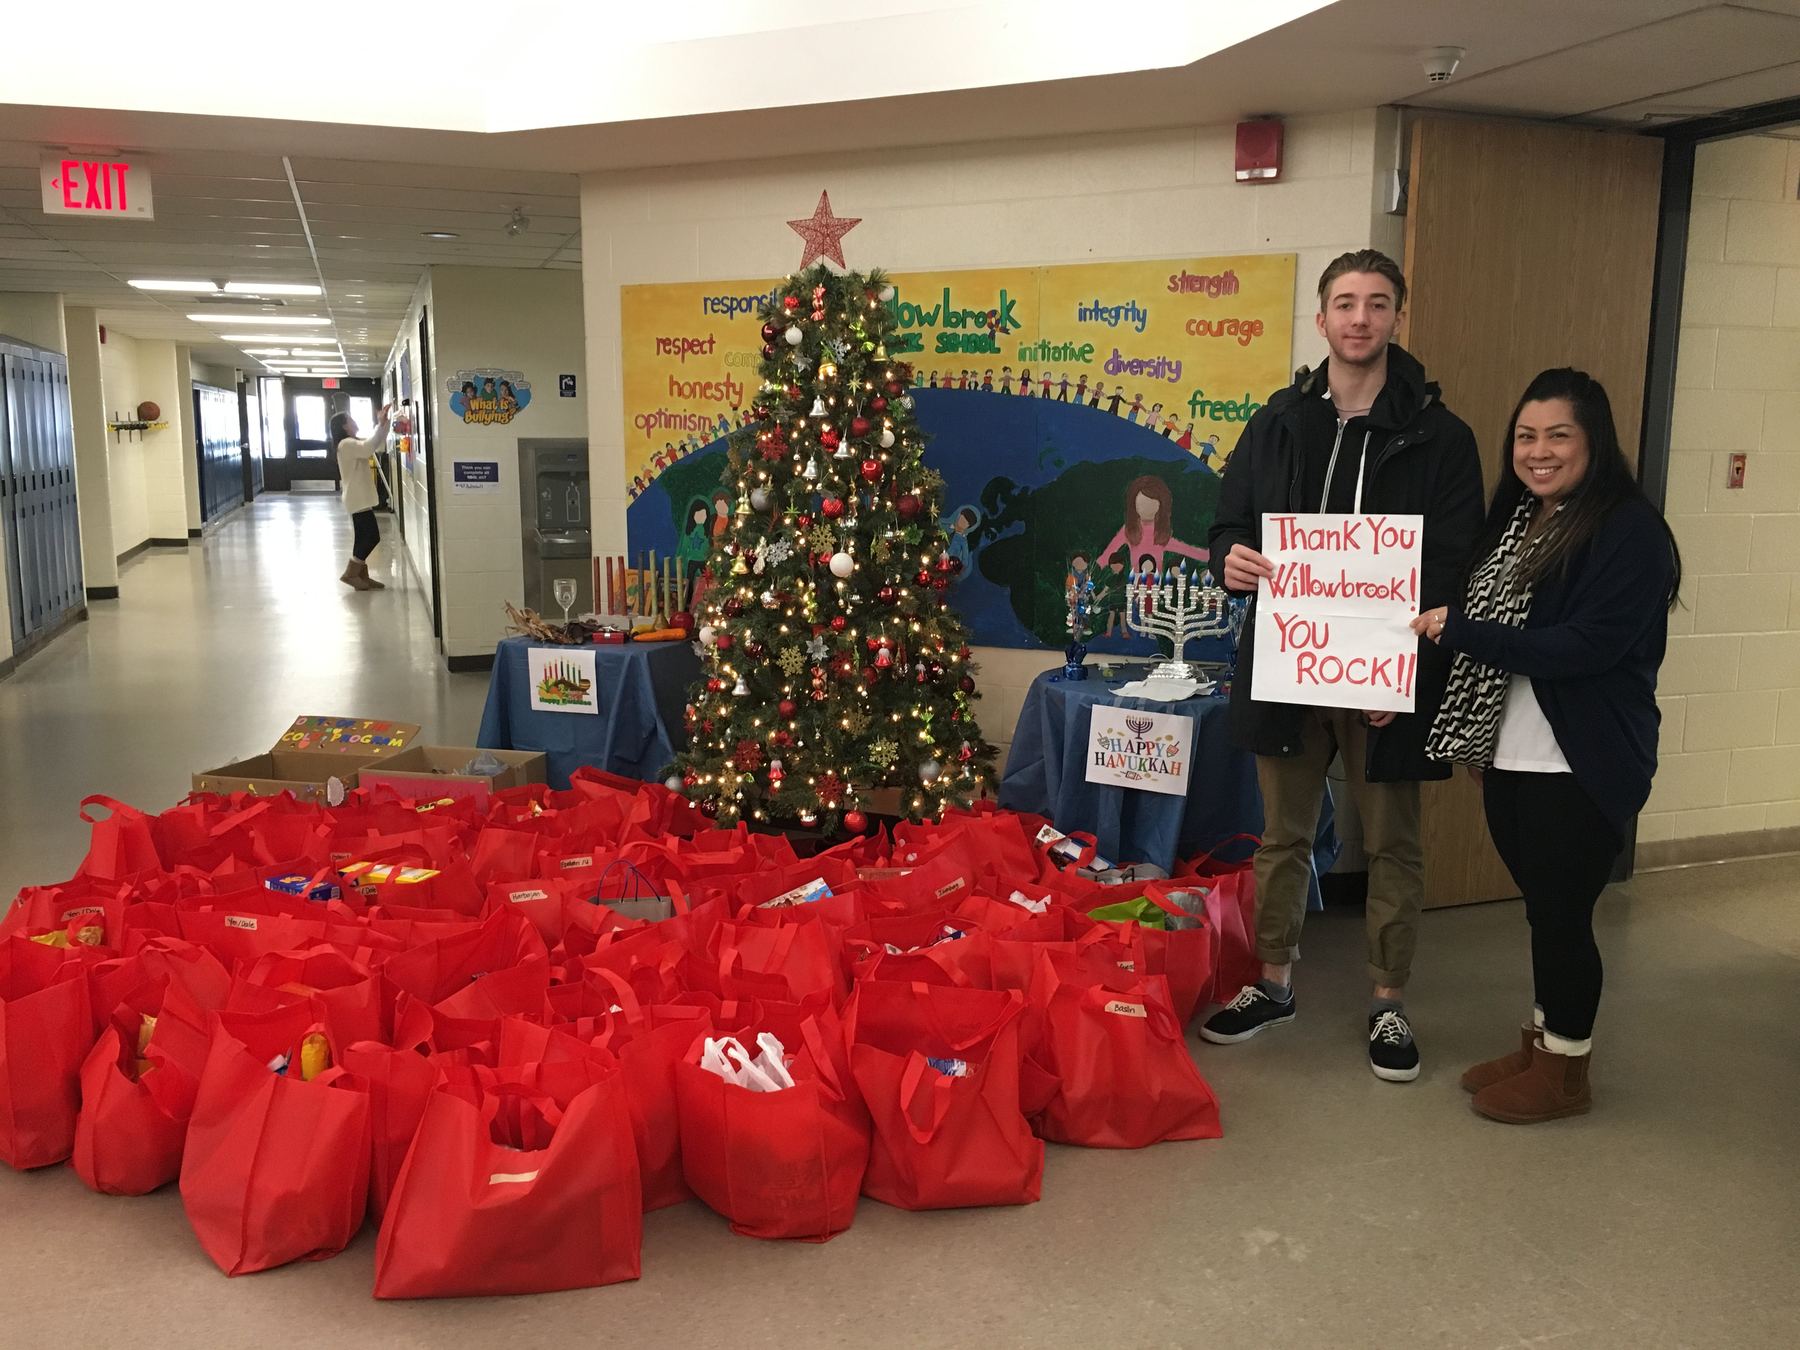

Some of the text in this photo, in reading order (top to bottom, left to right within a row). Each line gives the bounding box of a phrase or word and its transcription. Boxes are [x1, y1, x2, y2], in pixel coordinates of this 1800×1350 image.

[61, 160, 129, 211] EXIT
[1167, 269, 1239, 298] strength
[703, 288, 778, 320] responsi
[1078, 299, 1147, 333] integrity
[656, 333, 715, 364] respect
[1185, 318, 1264, 347] courage
[1018, 339, 1095, 363] initiative
[1104, 348, 1182, 383] diversity
[669, 372, 743, 408] honesty
[635, 408, 712, 439] optimism
[1366, 516, 1417, 554] You
[1273, 612, 1330, 653] YOU
[1296, 651, 1416, 698] ROCK!!
[1094, 751, 1183, 776] HANUKKAH
[1110, 738, 1166, 758] HAPPY
